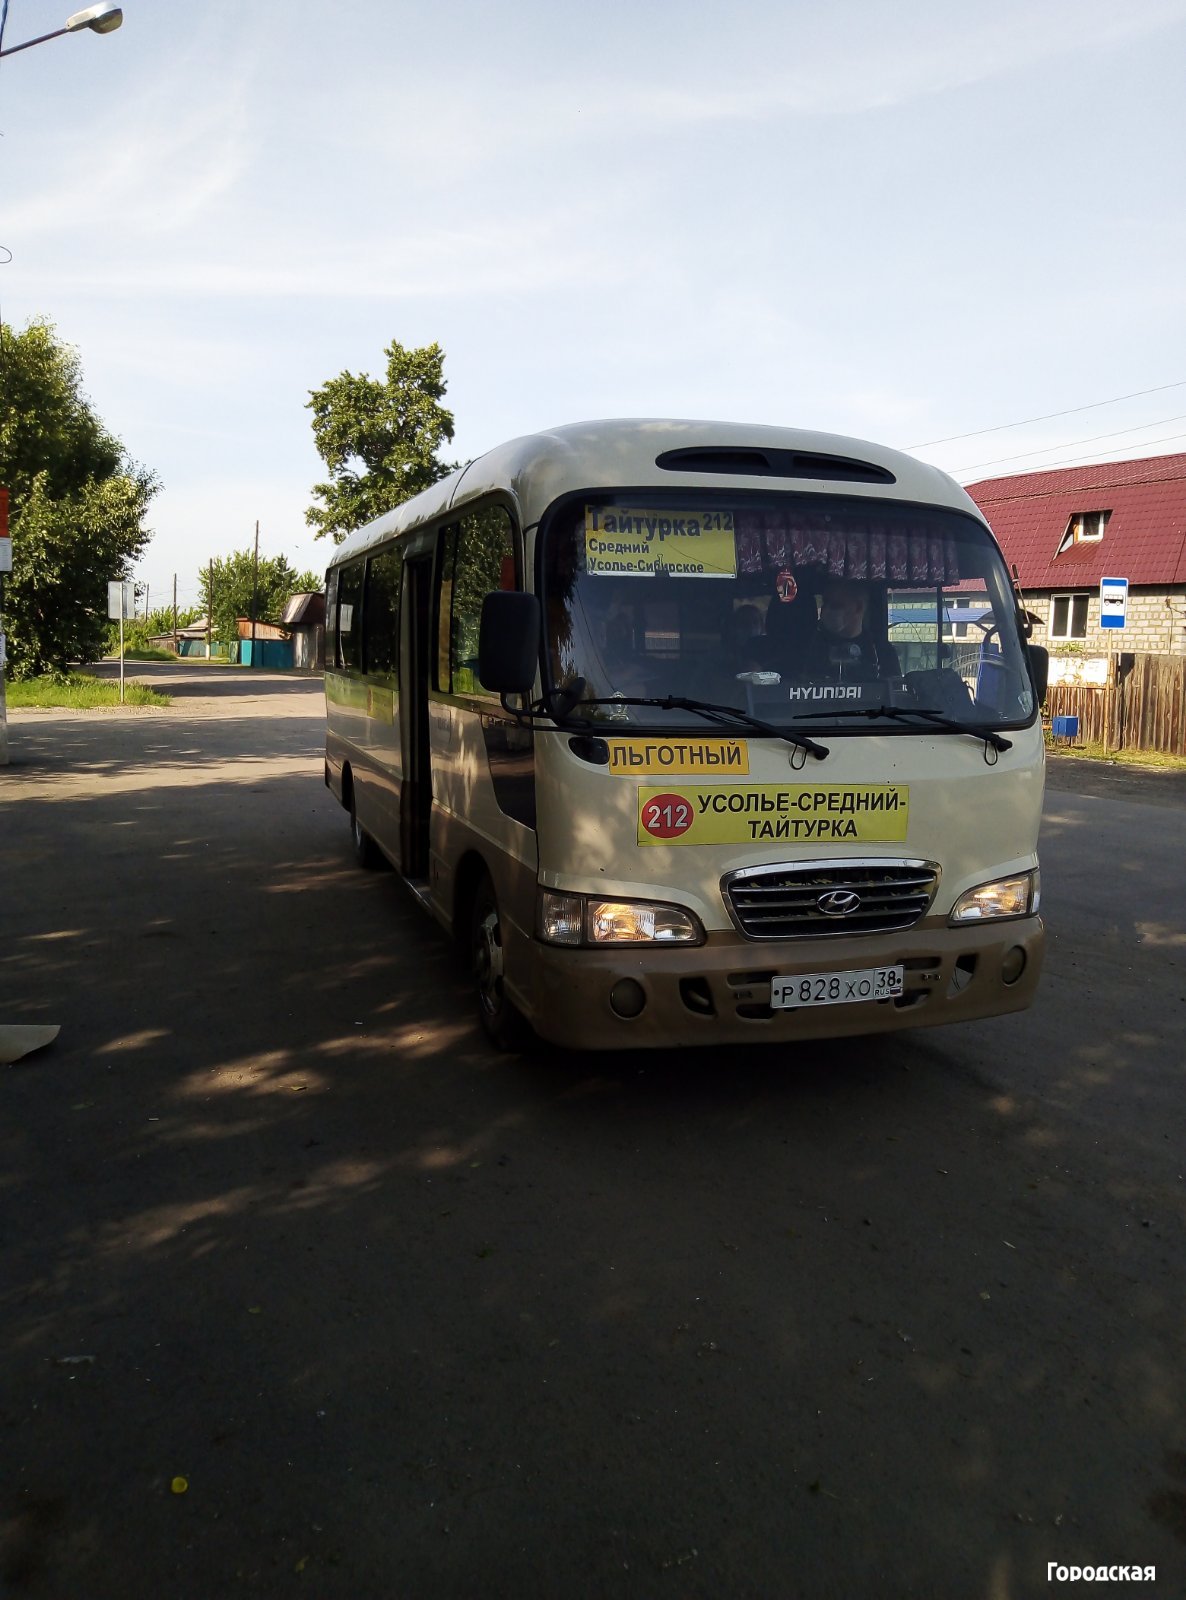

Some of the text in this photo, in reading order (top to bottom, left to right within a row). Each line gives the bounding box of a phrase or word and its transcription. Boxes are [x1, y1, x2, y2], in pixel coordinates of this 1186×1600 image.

[588, 507, 733, 541] Тайтурка 212
[588, 538, 650, 554] Средний
[589, 557, 704, 573] Усолье-Сибирское
[789, 686, 862, 699] HYUNDAI
[611, 741, 742, 766] ЛЬГОТНЫЙ
[647, 788, 906, 828] 212 УСОЛЬЕ-СРЕДНИЙ-
[748, 815, 858, 838] ТАЙТУРКА
[877, 970, 896, 988] 38
[874, 988, 890, 997] RUS
